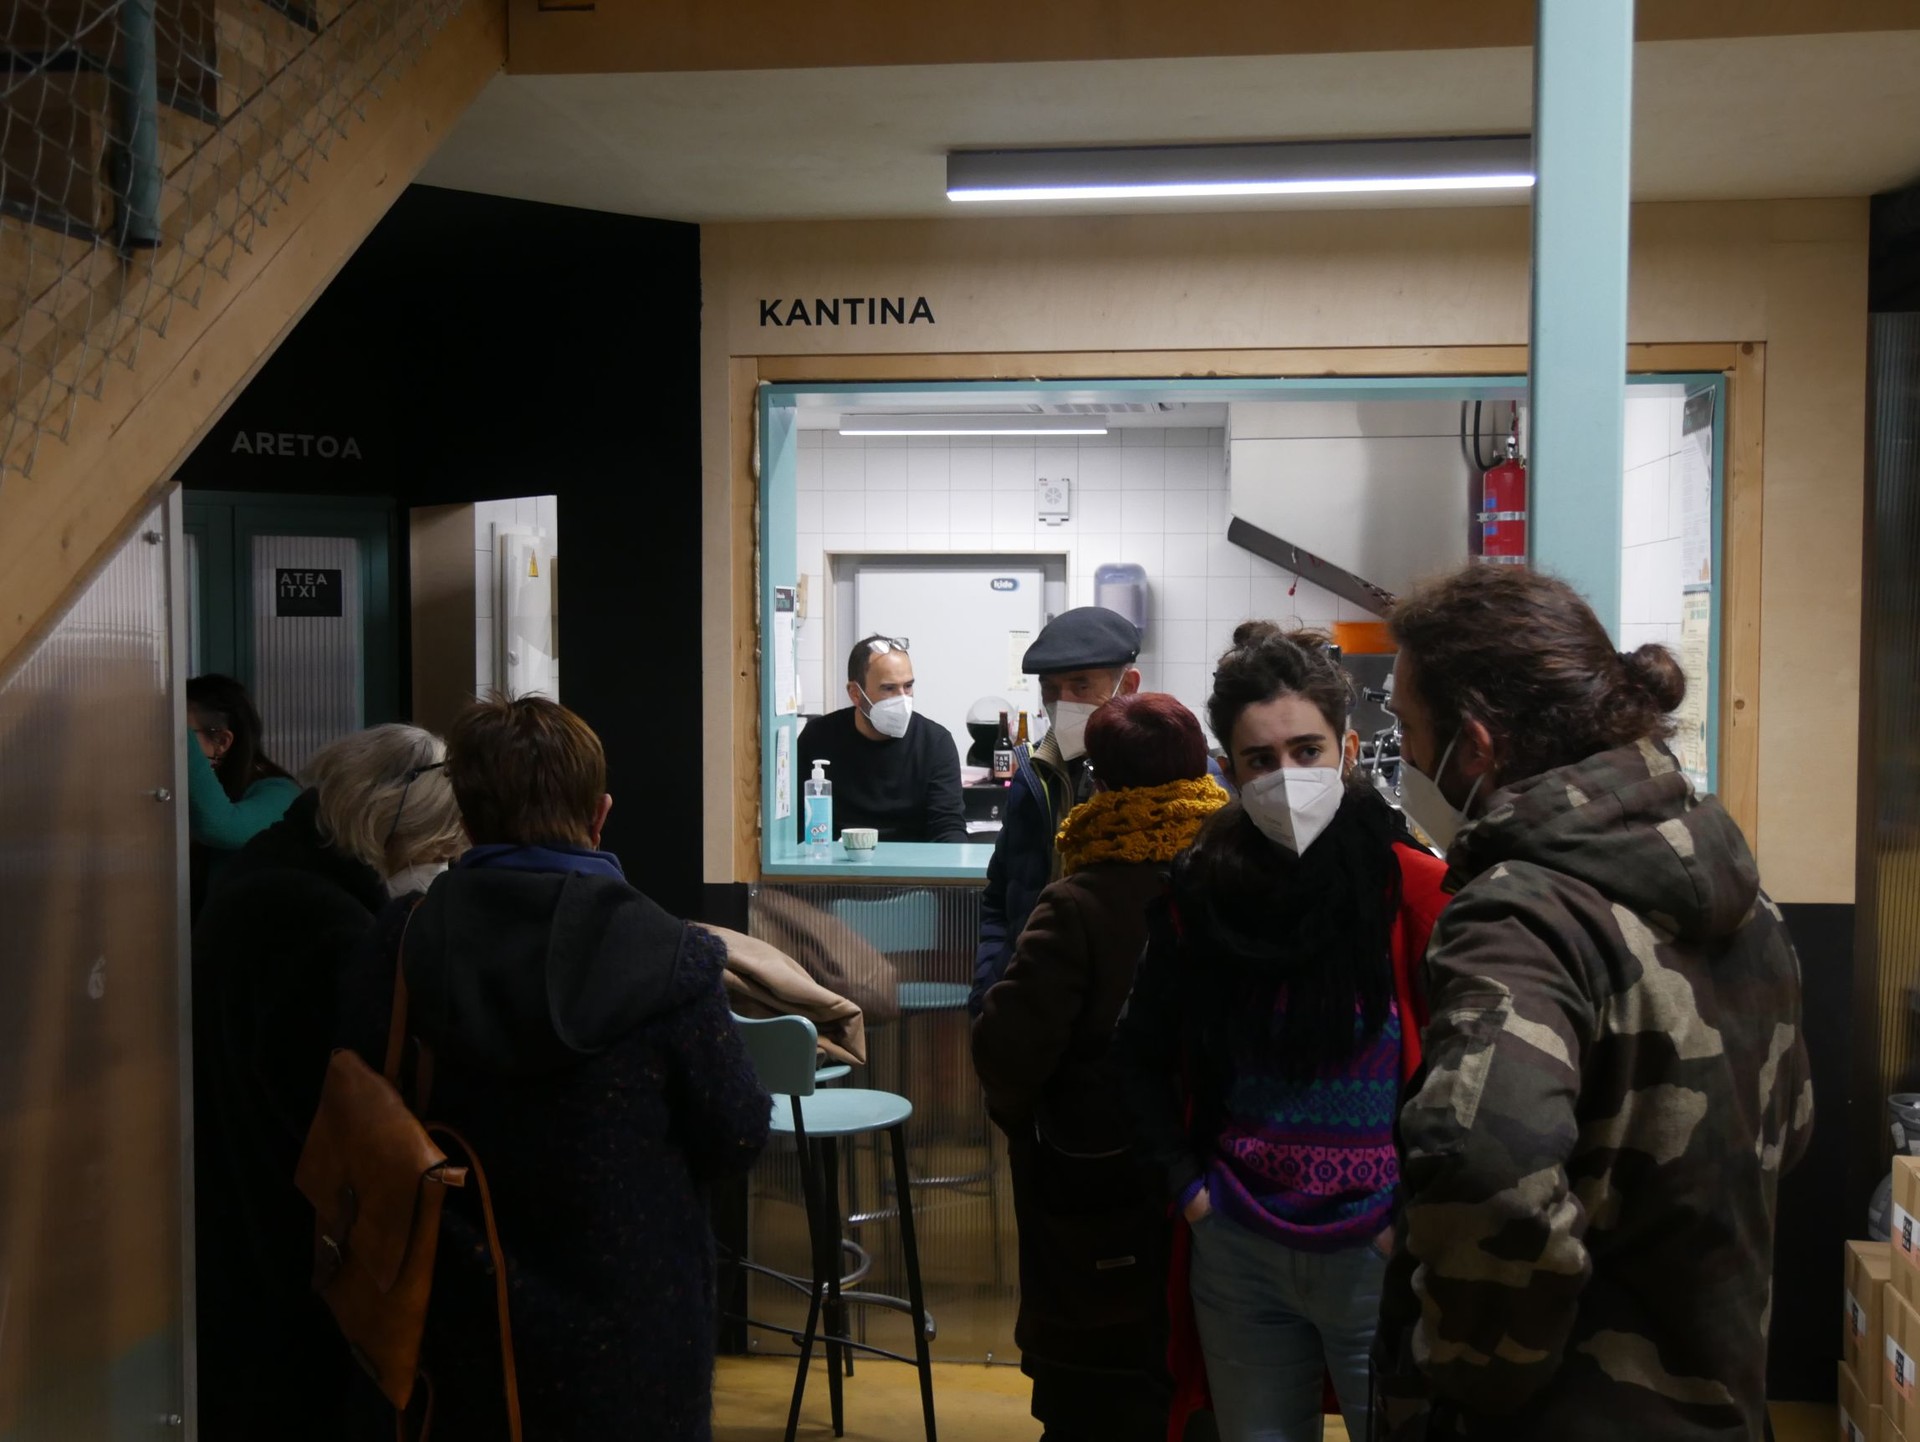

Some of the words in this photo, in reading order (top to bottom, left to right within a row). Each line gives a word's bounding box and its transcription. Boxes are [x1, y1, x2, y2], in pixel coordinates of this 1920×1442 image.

[760, 296, 936, 326] KANTINA
[231, 430, 363, 460] ARETOA
[280, 572, 328, 585] ATEA
[280, 585, 316, 598] ITXI
